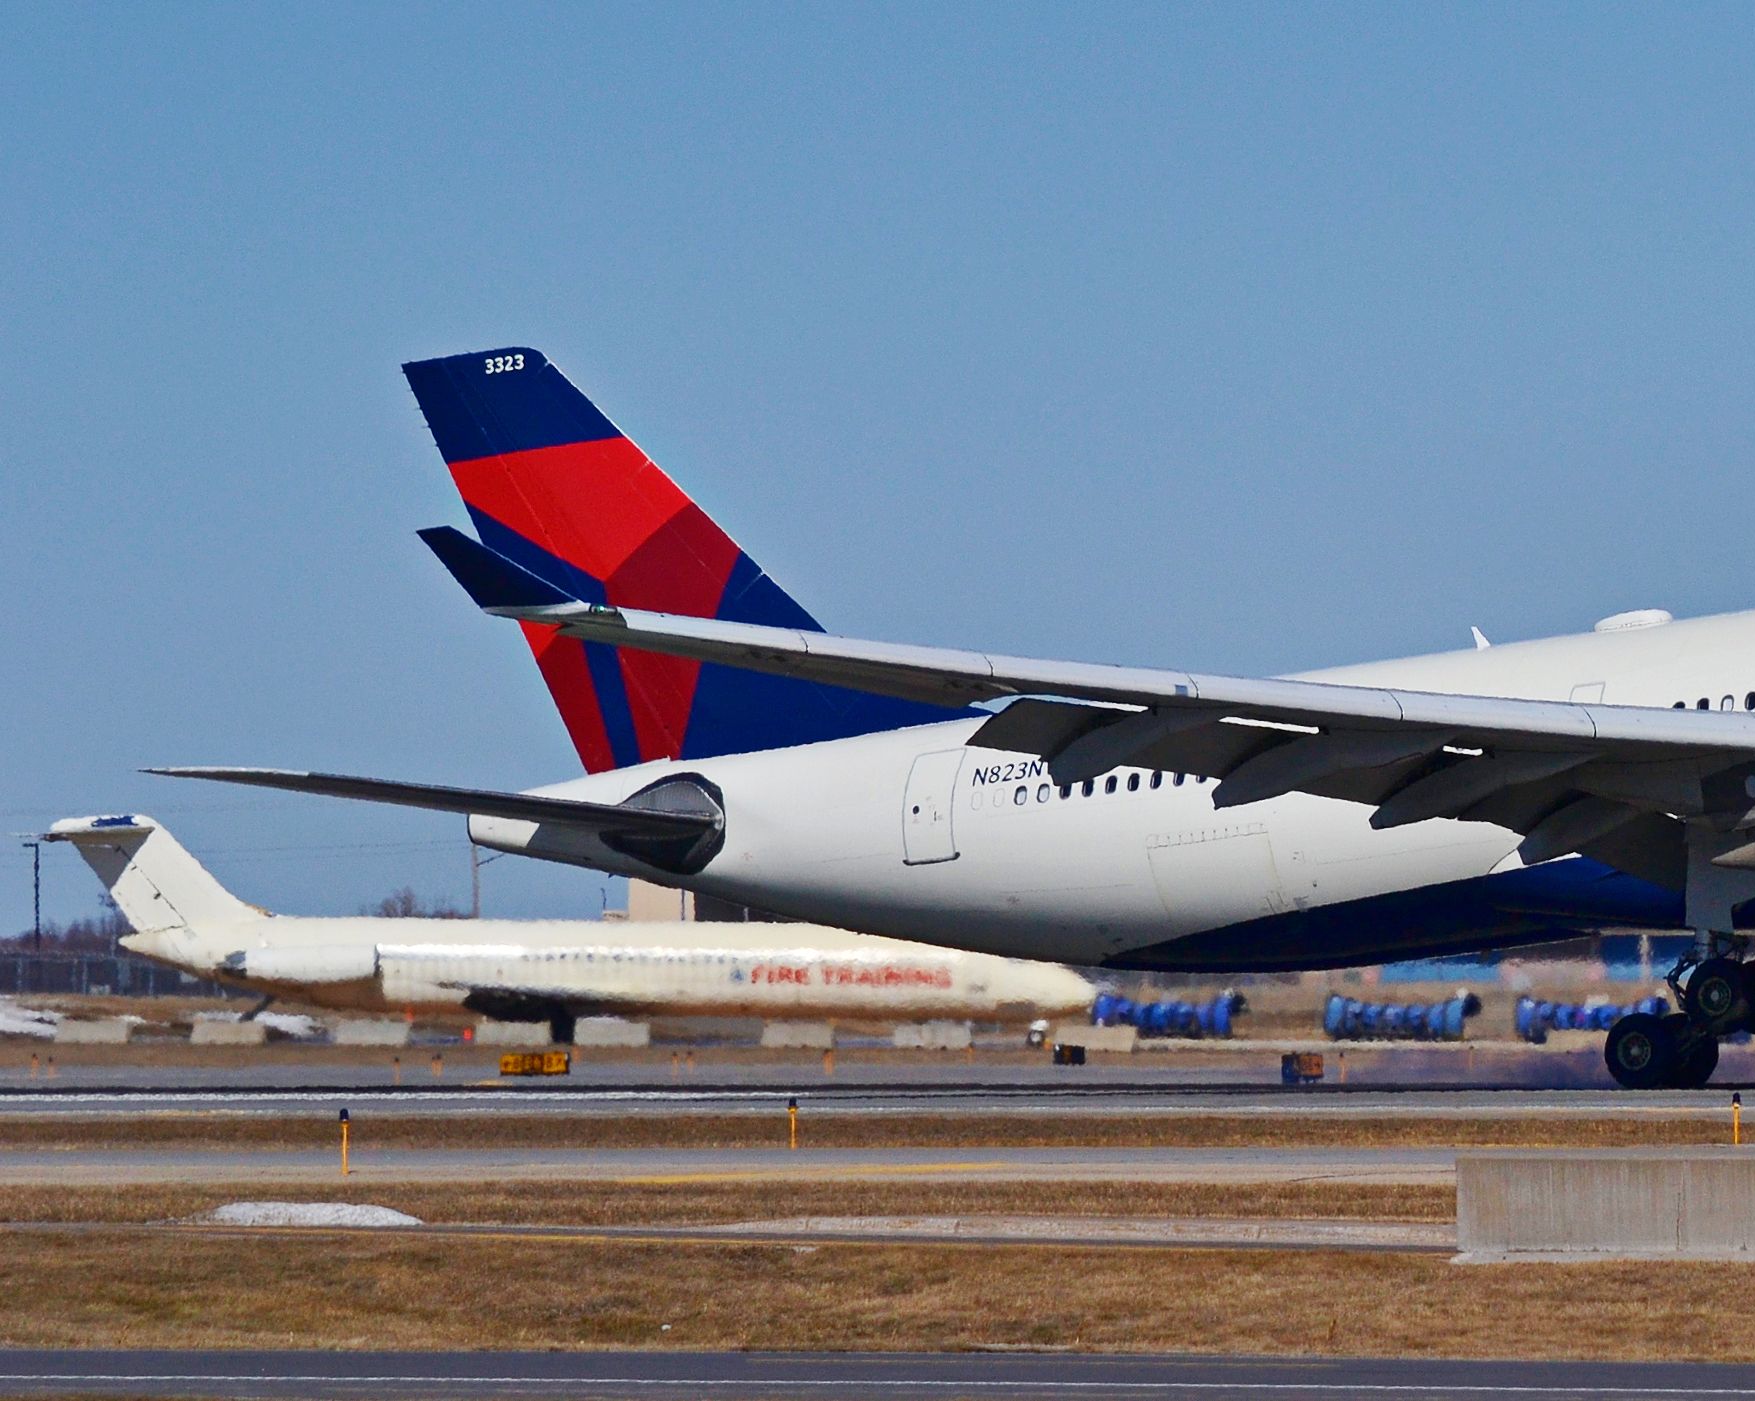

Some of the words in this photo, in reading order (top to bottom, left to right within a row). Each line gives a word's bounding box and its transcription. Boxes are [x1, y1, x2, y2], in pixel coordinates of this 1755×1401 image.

[485, 354, 525, 375] 3323
[751, 963, 809, 985] FIRE
[821, 964, 953, 989] TRAINING
